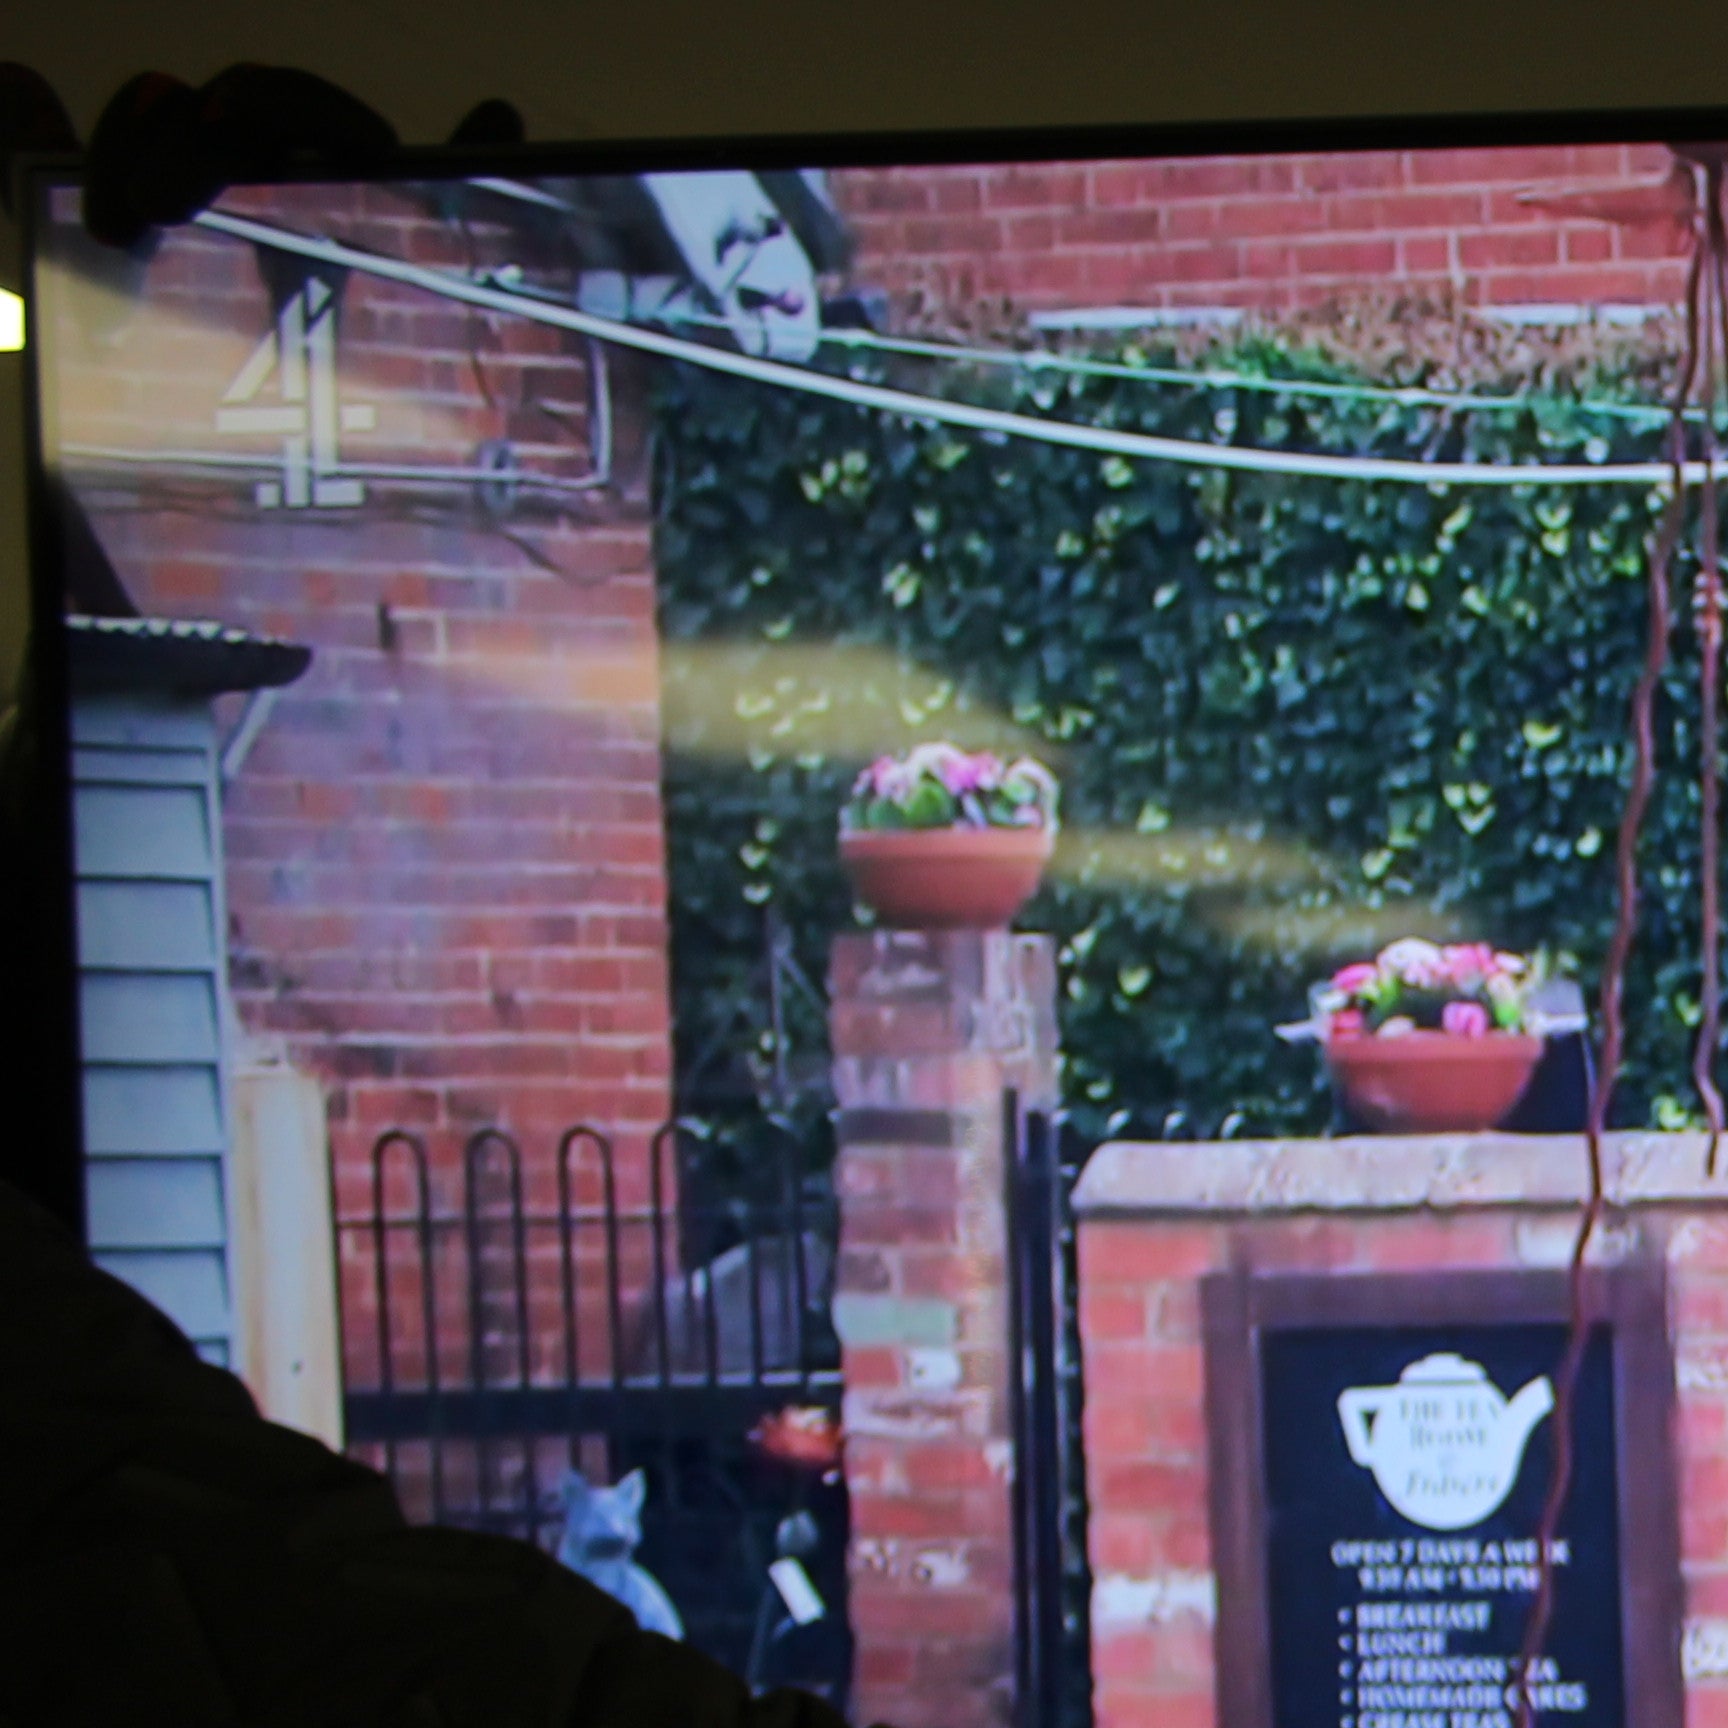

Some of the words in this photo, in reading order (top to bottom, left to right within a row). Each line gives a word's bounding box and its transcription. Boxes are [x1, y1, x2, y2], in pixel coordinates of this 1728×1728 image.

[216, 276, 375, 508] 4
[1331, 1539, 1397, 1566] OPEN
[1503, 1539, 1569, 1565] WEK
[1356, 1602, 1491, 1631] BREAKFAST
[1357, 1630, 1447, 1657] LUNCH
[1357, 1656, 1507, 1683] AFTERNOON
